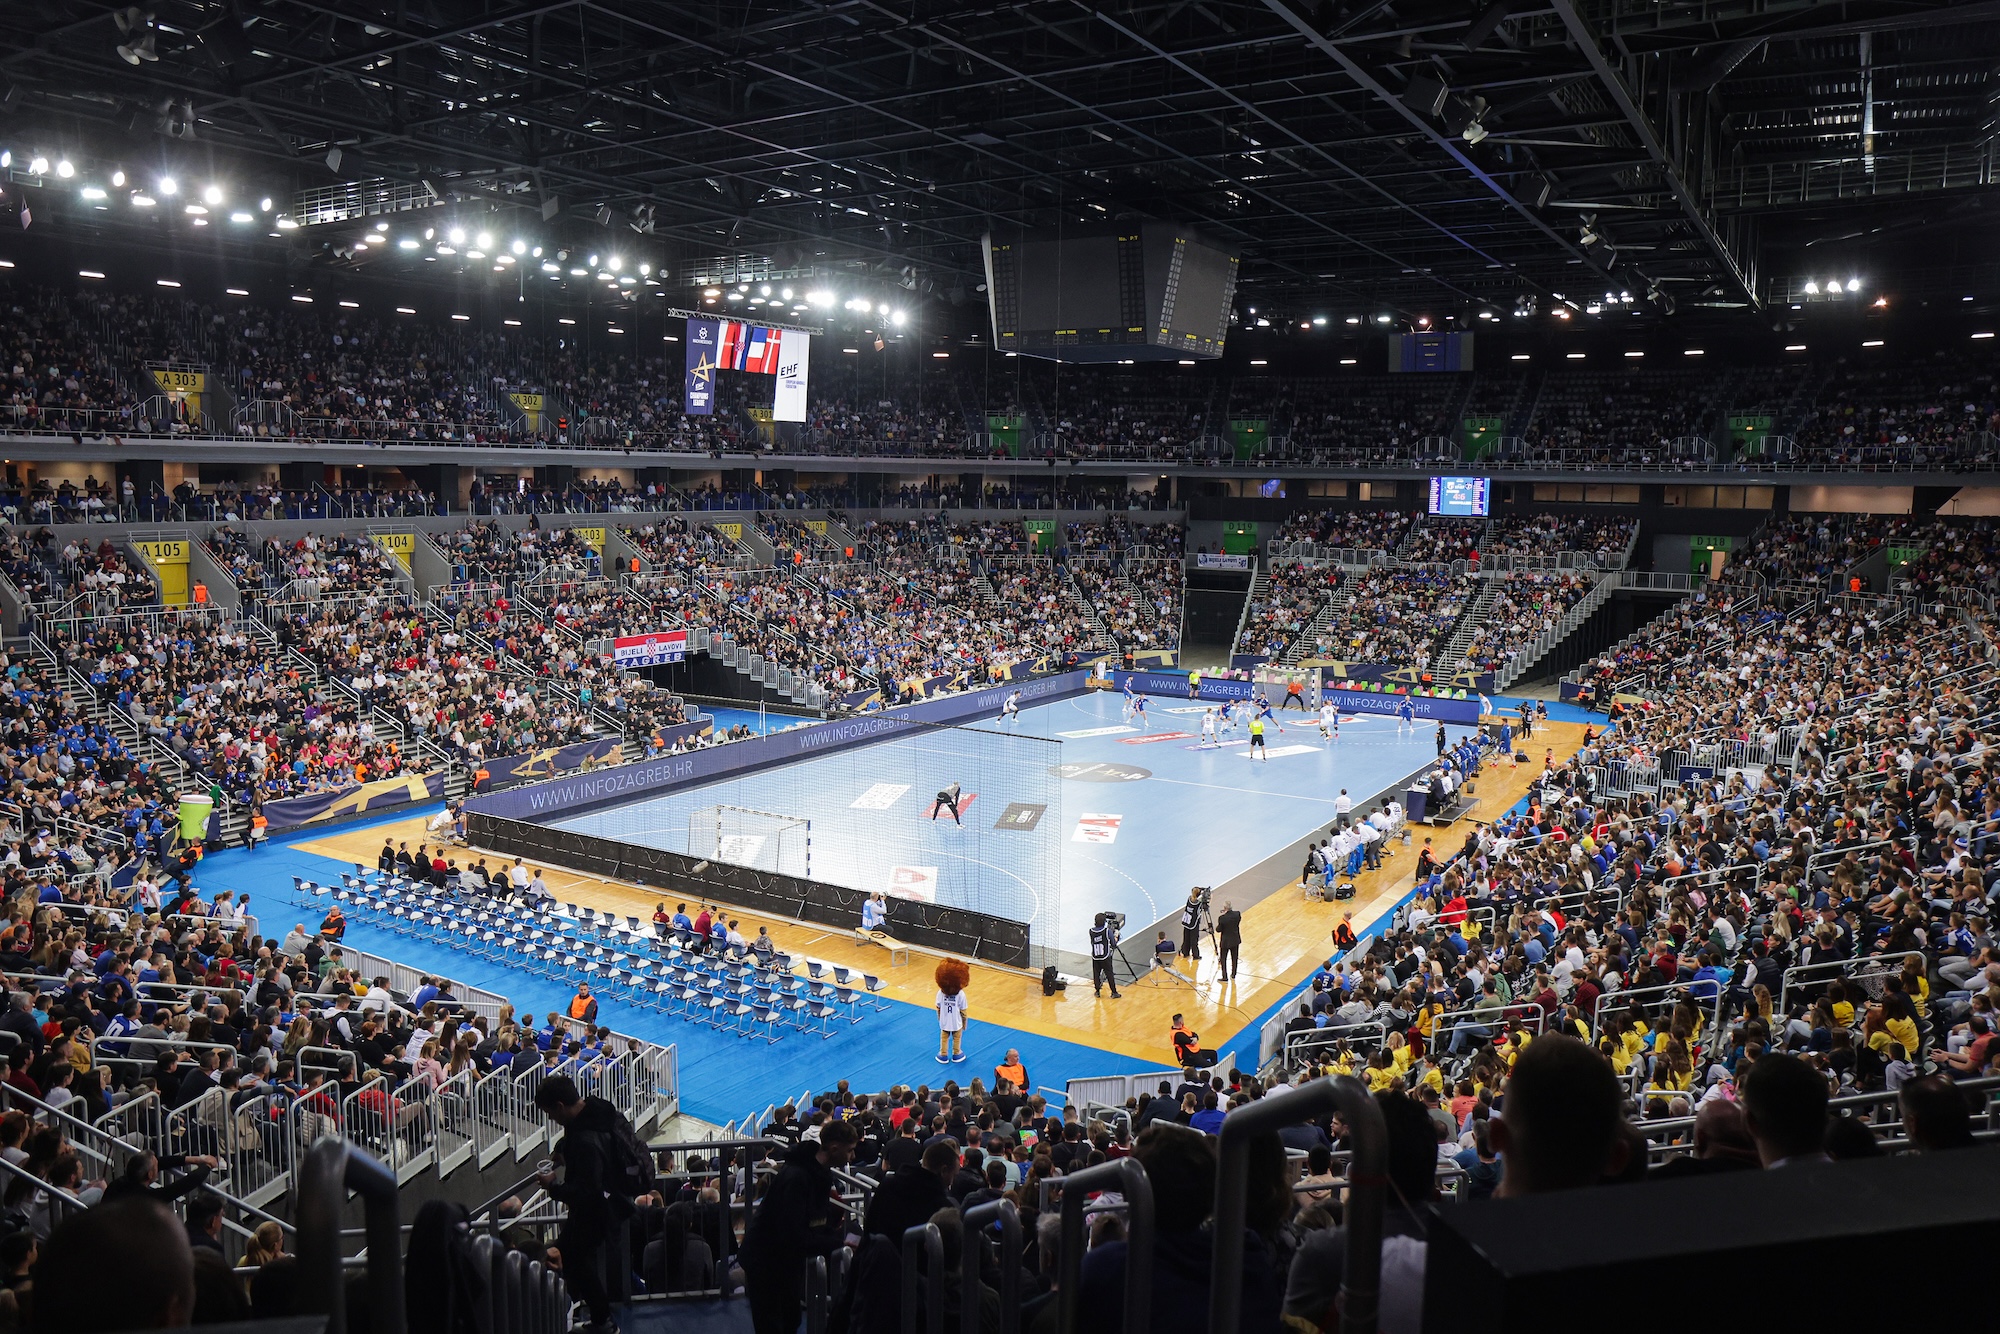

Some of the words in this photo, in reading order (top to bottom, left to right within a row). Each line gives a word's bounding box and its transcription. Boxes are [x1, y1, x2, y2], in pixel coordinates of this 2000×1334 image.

[781, 363, 798, 376] EHF
[163, 373, 171, 384] A
[175, 374, 196, 386] 303
[523, 396, 538, 405] 302
[760, 410, 772, 418] 301
[1736, 418, 1742, 426] D
[1746, 418, 1764, 426] 315
[388, 536, 407, 548] 104
[1698, 537, 1703, 545] D
[1707, 538, 1725, 546] 118
[141, 544, 150, 558] A
[155, 544, 180, 556] 105
[1893, 550, 1899, 559] D
[621, 648, 643, 656] BIJELI
[659, 643, 682, 652] LAVOVI
[621, 653, 682, 667] ZAGREB
[800, 713, 909, 748] WWW.INFOZAGREB.HR
[530, 760, 693, 810] WWW.INFOZAGREB.HR
[1094, 944, 1104, 956] HB
[1323, 979, 1329, 987] 5
